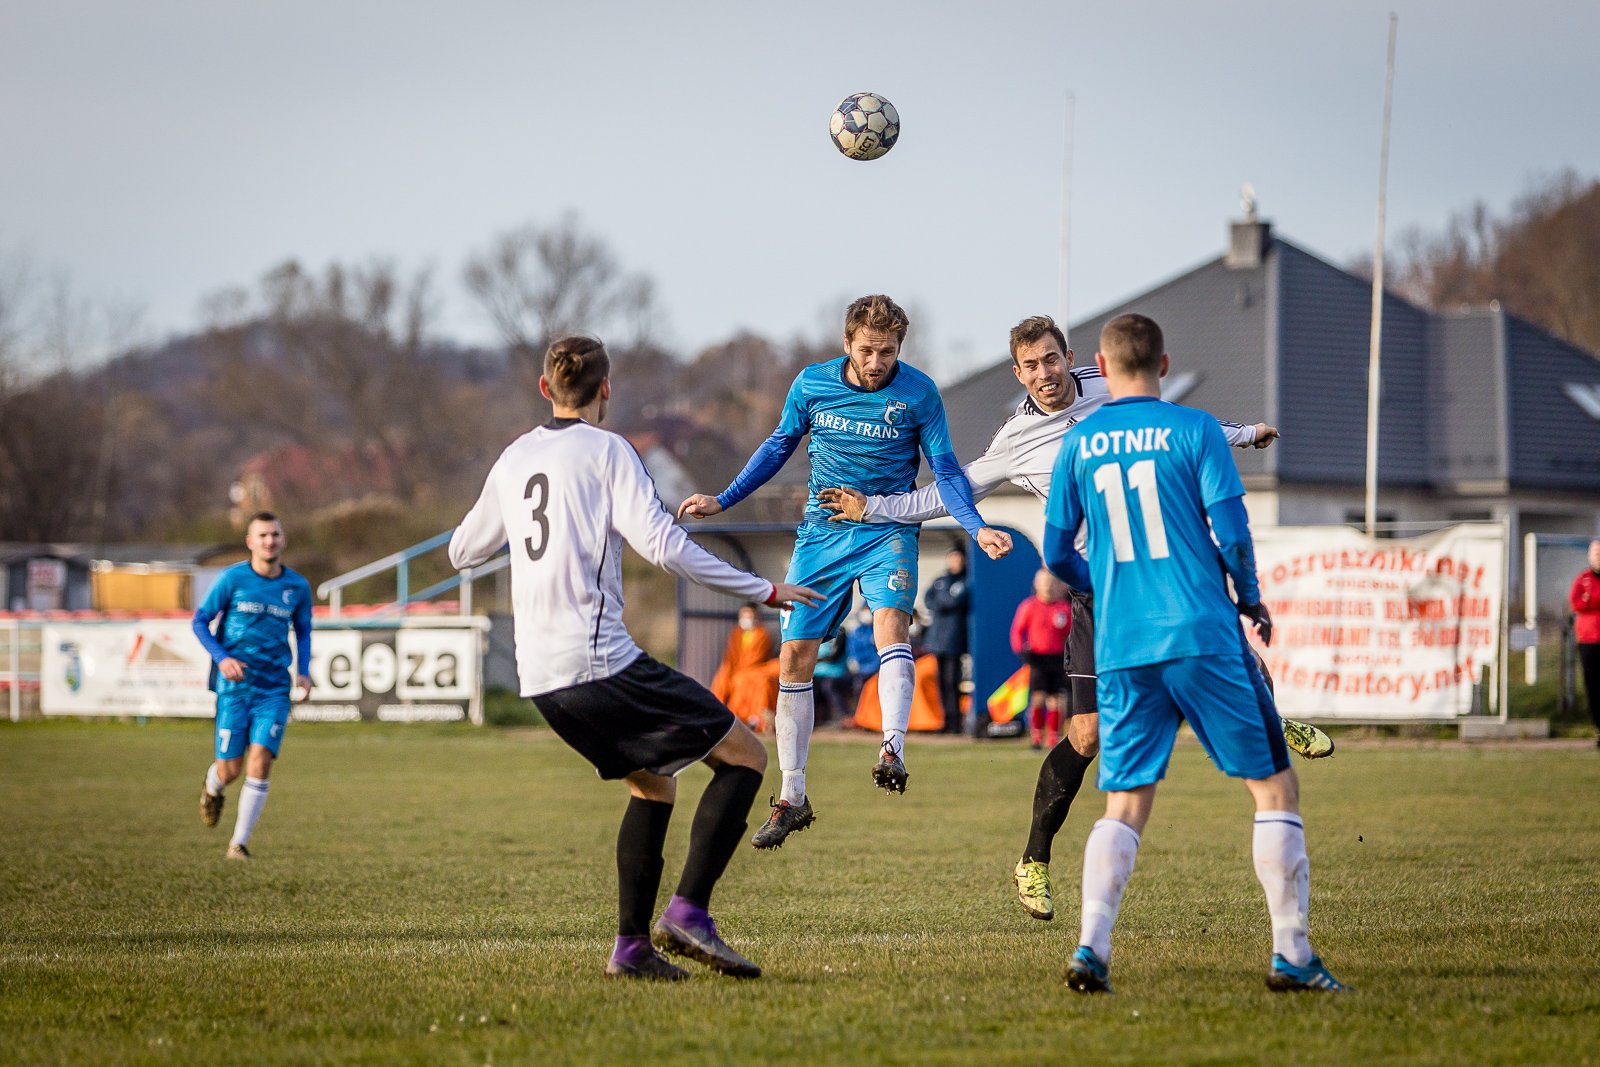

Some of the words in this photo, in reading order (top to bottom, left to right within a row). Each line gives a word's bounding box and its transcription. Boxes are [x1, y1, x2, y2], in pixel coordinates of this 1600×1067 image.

[814, 411, 899, 439] JAREX-TRANS
[1080, 427, 1172, 460] LOTNIK
[523, 472, 550, 562] 3
[1093, 459, 1170, 563] 11
